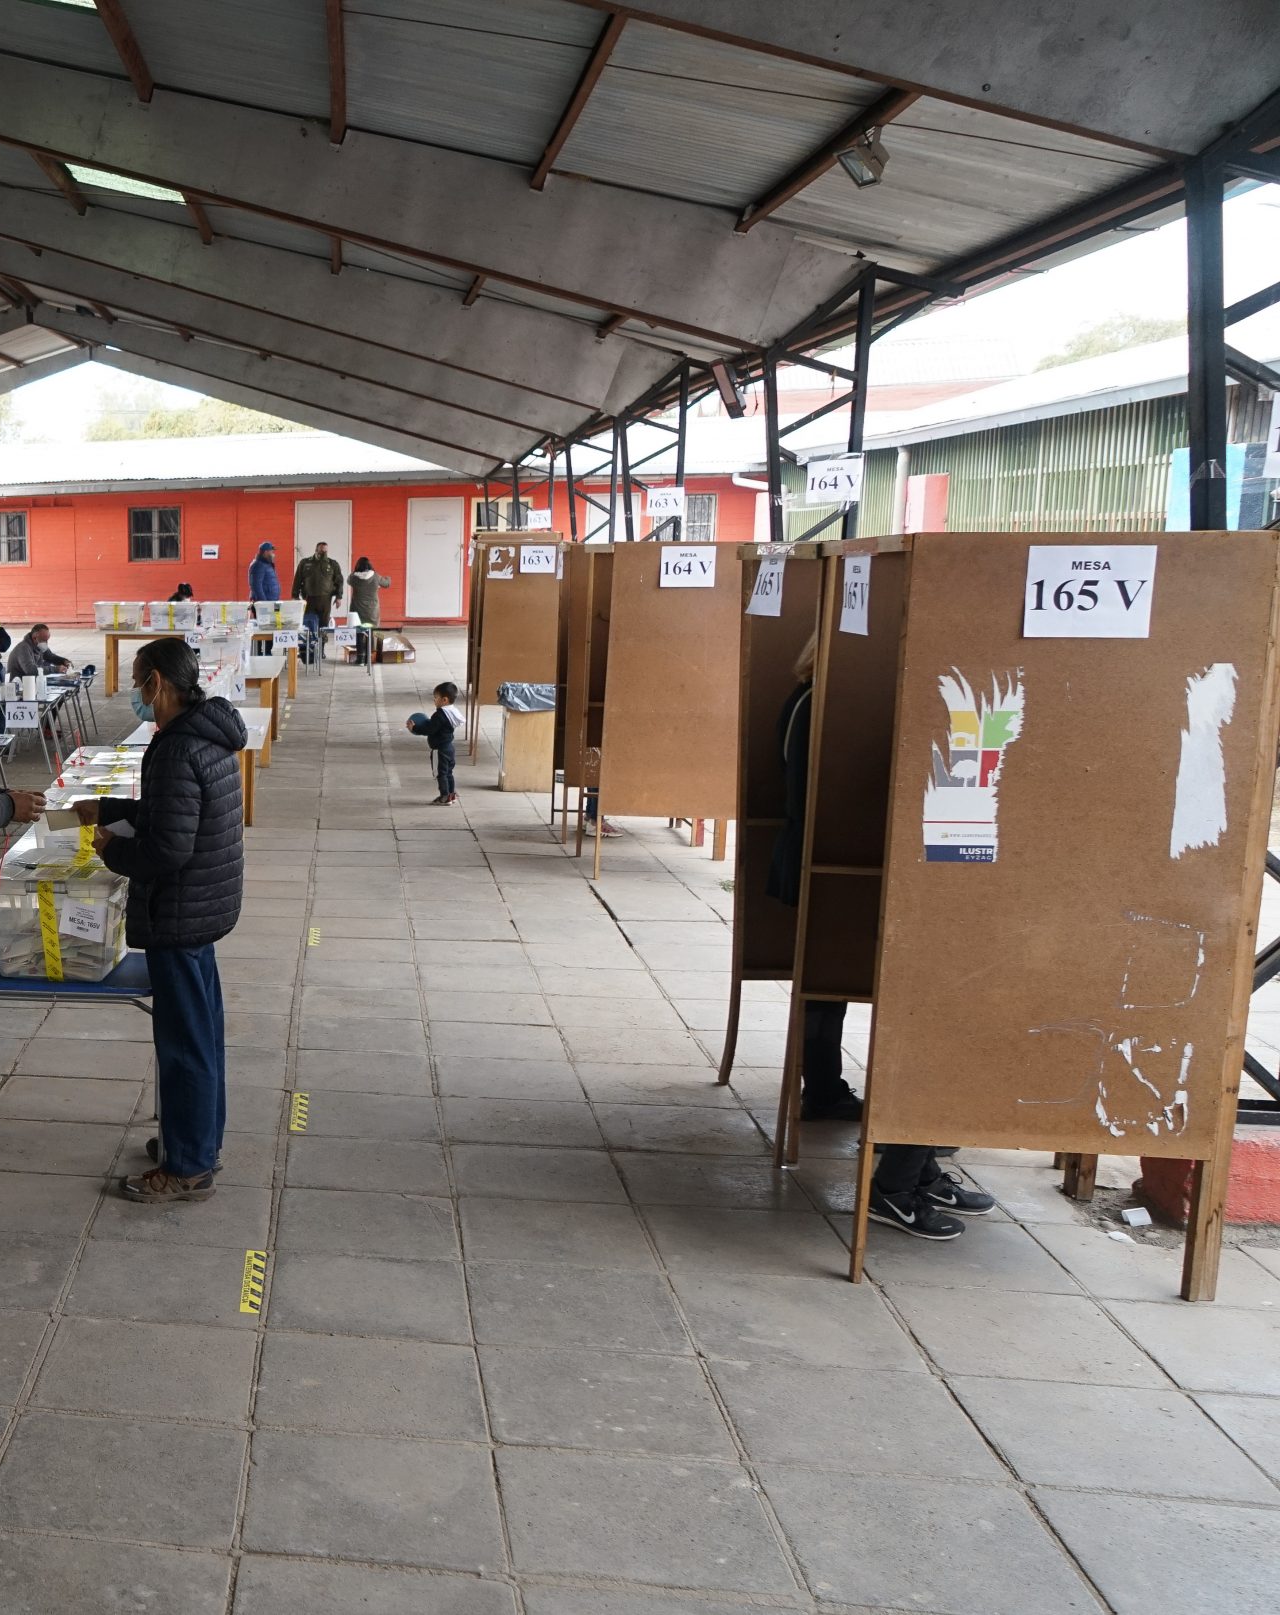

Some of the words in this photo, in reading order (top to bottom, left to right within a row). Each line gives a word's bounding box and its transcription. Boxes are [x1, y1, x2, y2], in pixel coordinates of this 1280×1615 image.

[809, 475, 838, 490] 164
[846, 474, 859, 489] V
[650, 498, 668, 508] 163
[673, 498, 681, 507] V
[523, 555, 540, 565] 163
[544, 555, 553, 565] V
[1071, 561, 1112, 571] MESA
[663, 561, 692, 575] 164
[699, 561, 712, 575] V
[754, 572, 775, 596] 165
[844, 581, 858, 610] 165
[860, 582, 868, 611] V
[1029, 579, 1100, 612] 165
[1114, 580, 1148, 612] V
[7, 711, 24, 720] 163
[29, 711, 36, 720] V
[959, 847, 993, 855] ILUSTR
